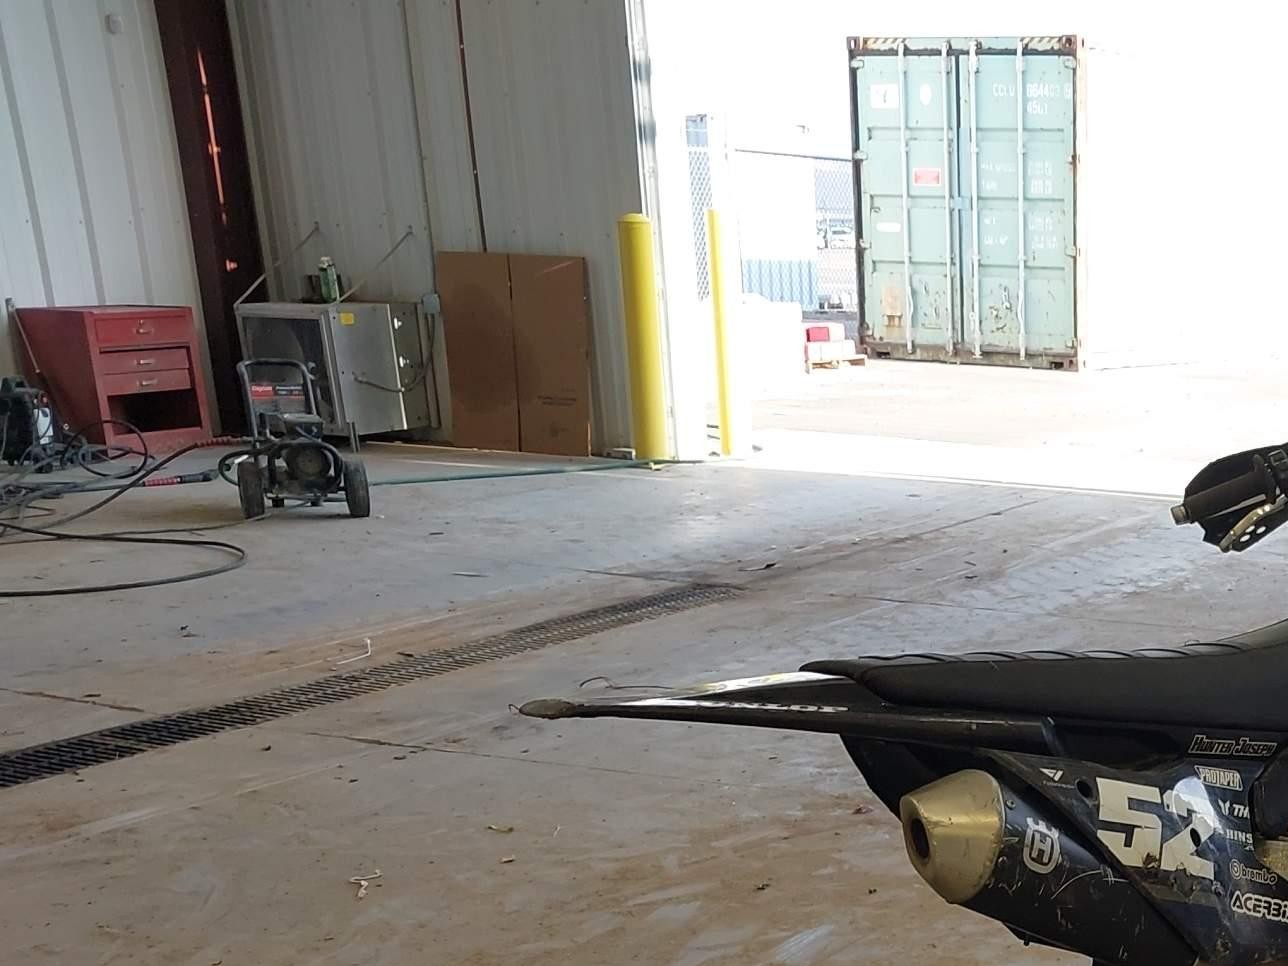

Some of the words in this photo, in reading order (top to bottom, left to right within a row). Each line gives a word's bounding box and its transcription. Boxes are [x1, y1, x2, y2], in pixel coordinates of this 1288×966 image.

[1189, 735, 1235, 755] HUNTER
[1233, 737, 1278, 757] JOSEPH
[1199, 767, 1240, 789] PROTAPER
[1096, 777, 1215, 881] 52
[1240, 863, 1278, 885] brembo
